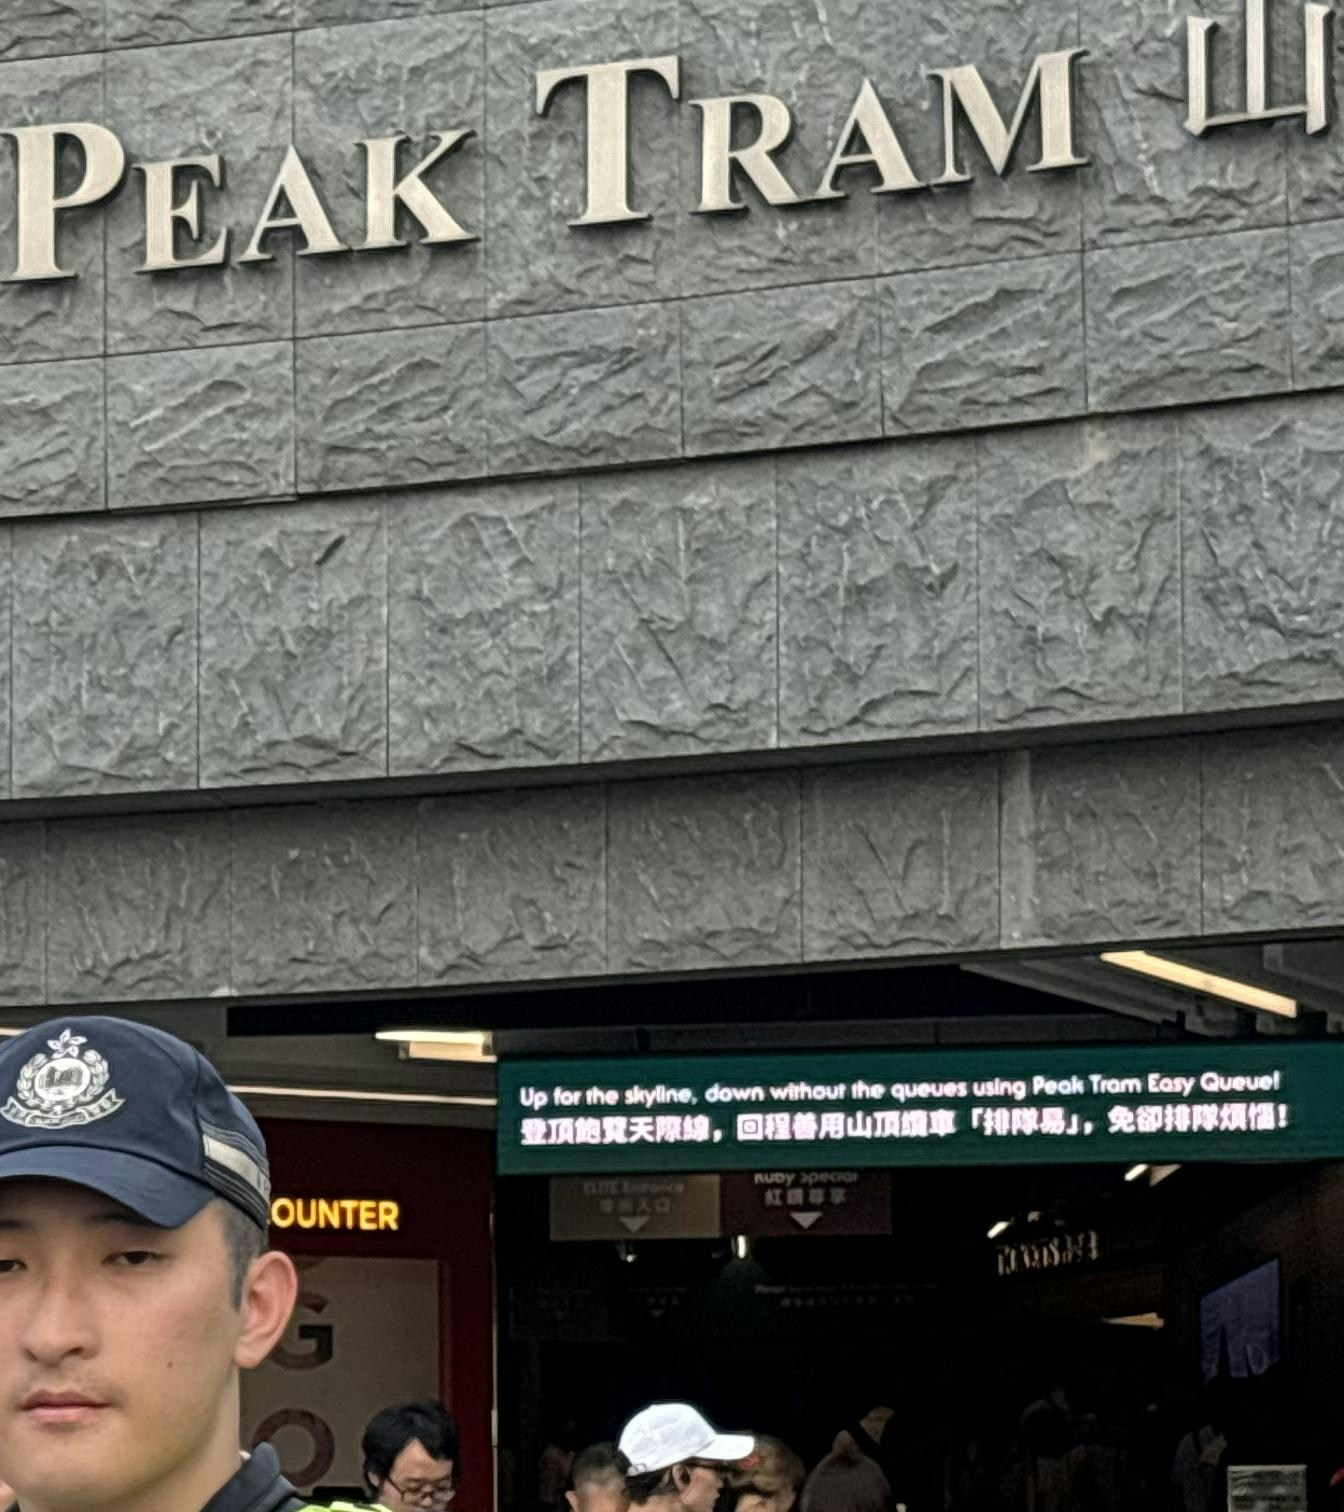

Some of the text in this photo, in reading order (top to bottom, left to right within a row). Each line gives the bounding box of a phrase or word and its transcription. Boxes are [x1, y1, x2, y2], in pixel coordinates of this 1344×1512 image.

[1183, 0, 1330, 136] 山
[535, 48, 1092, 227] TRAM
[520, 1086, 547, 1111] Up
[553, 1086, 581, 1106] for
[585, 1085, 619, 1106] the
[624, 1083, 698, 1109] skyline,
[704, 1081, 764, 1104] down
[770, 1081, 846, 1103] without
[851, 1079, 886, 1101] the
[891, 1080, 967, 1103] queues
[972, 1077, 1027, 1102] using
[1032, 1075, 1084, 1098] Peak
[1088, 1073, 1143, 1096] Tram
[1147, 1071, 1195, 1098] Easy
[267, 1197, 400, 1231] OUNTER
